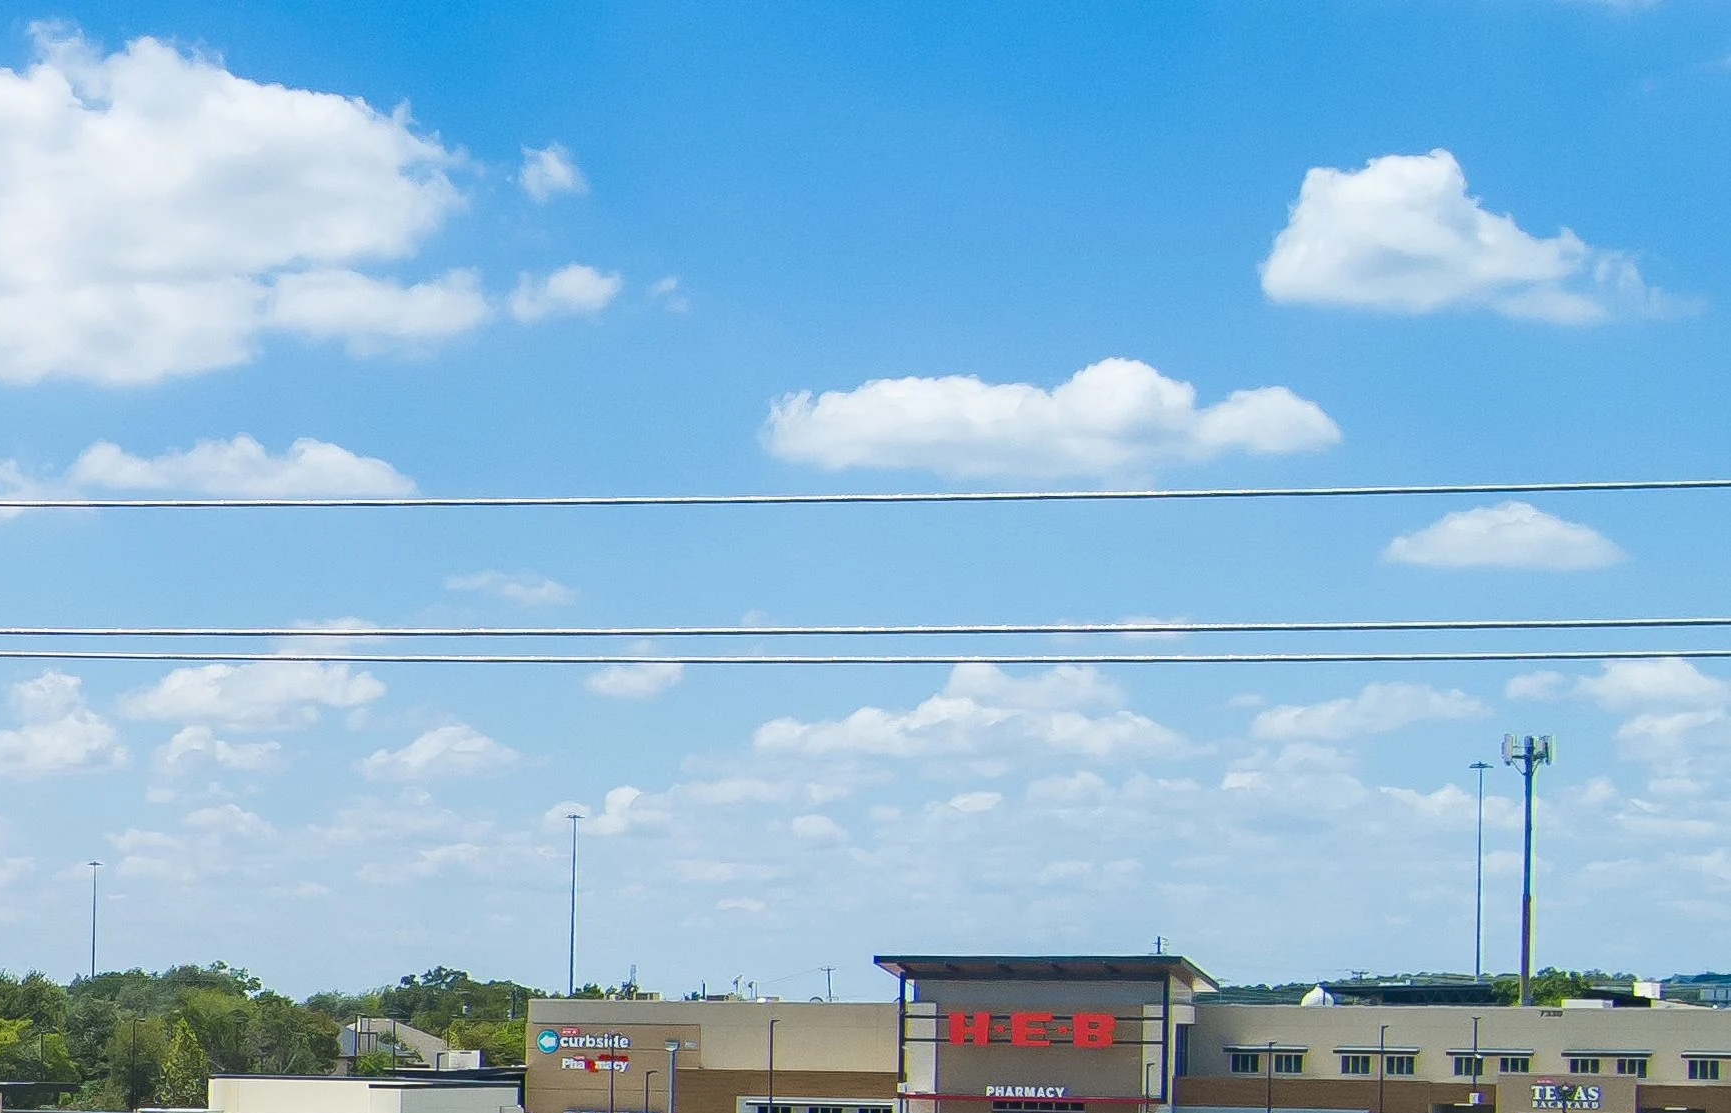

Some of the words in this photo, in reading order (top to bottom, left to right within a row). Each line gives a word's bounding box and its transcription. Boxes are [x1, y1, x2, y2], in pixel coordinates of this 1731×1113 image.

[560, 1034, 630, 1049] curbside
[986, 1086, 1066, 1098] PHARMACY
[1532, 1101, 1600, 1109] BACKYARD
